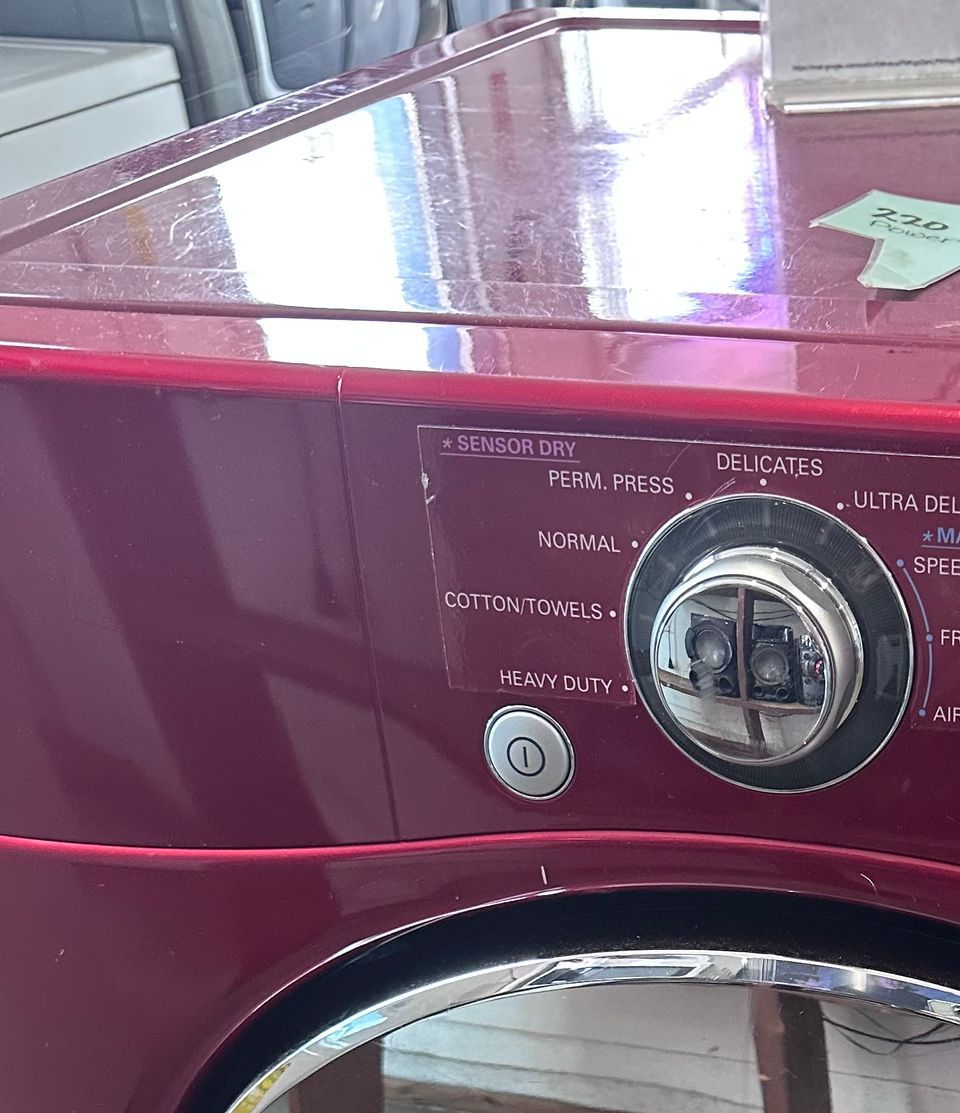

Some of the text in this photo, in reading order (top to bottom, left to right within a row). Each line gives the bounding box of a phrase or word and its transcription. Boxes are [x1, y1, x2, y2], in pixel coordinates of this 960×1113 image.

[871, 207, 949, 231] 220
[457, 434, 576, 458] SENSOR DRY
[716, 452, 824, 477] DELICATES
[549, 470, 675, 495] PERM. PRESS
[853, 490, 919, 512] ULTRA
[538, 531, 621, 553] NORMAL
[444, 591, 603, 620] COTTON/TOWELS
[500, 669, 613, 695] HEAVY DUTY
